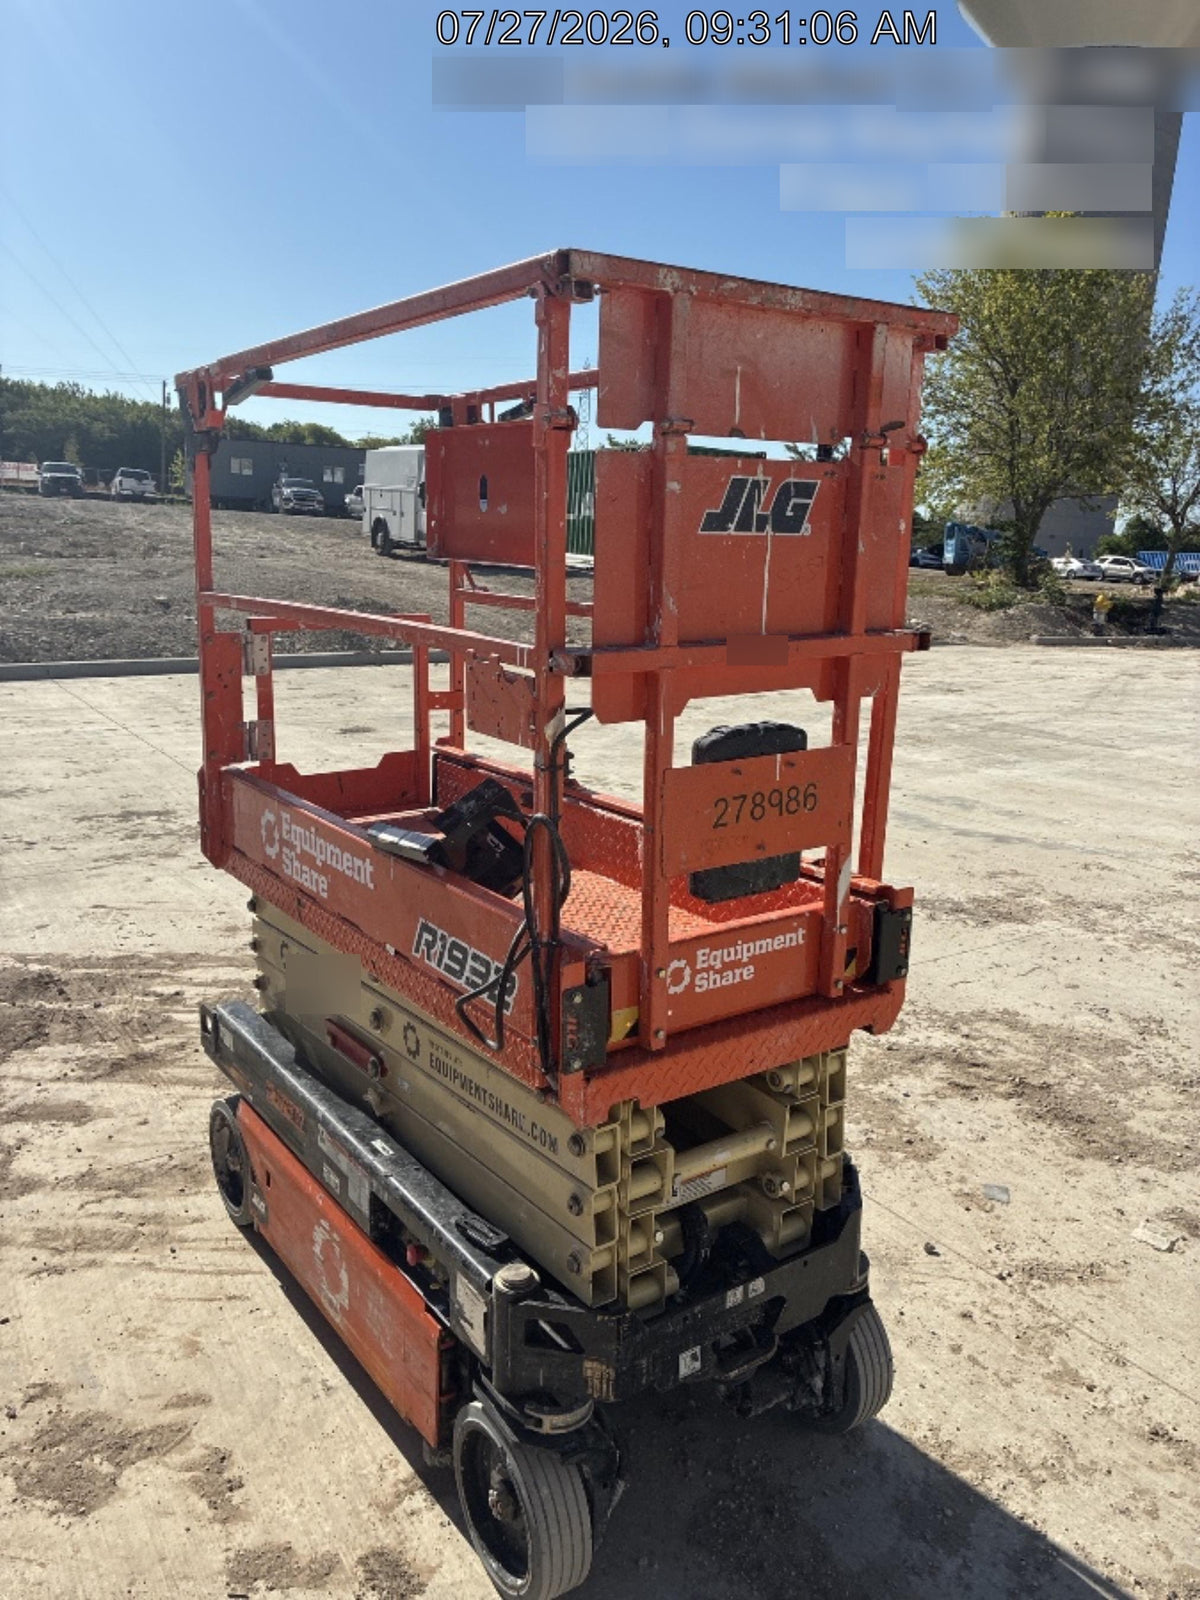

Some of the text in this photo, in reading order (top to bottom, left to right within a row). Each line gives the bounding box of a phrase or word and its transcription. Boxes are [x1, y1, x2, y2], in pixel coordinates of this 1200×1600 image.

[697, 475, 821, 536] JLG
[712, 783, 817, 829] 278986
[280, 811, 375, 890] Equipment
[282, 846, 328, 899] Share
[695, 927, 806, 970] Equipment
[694, 965, 755, 994] Share
